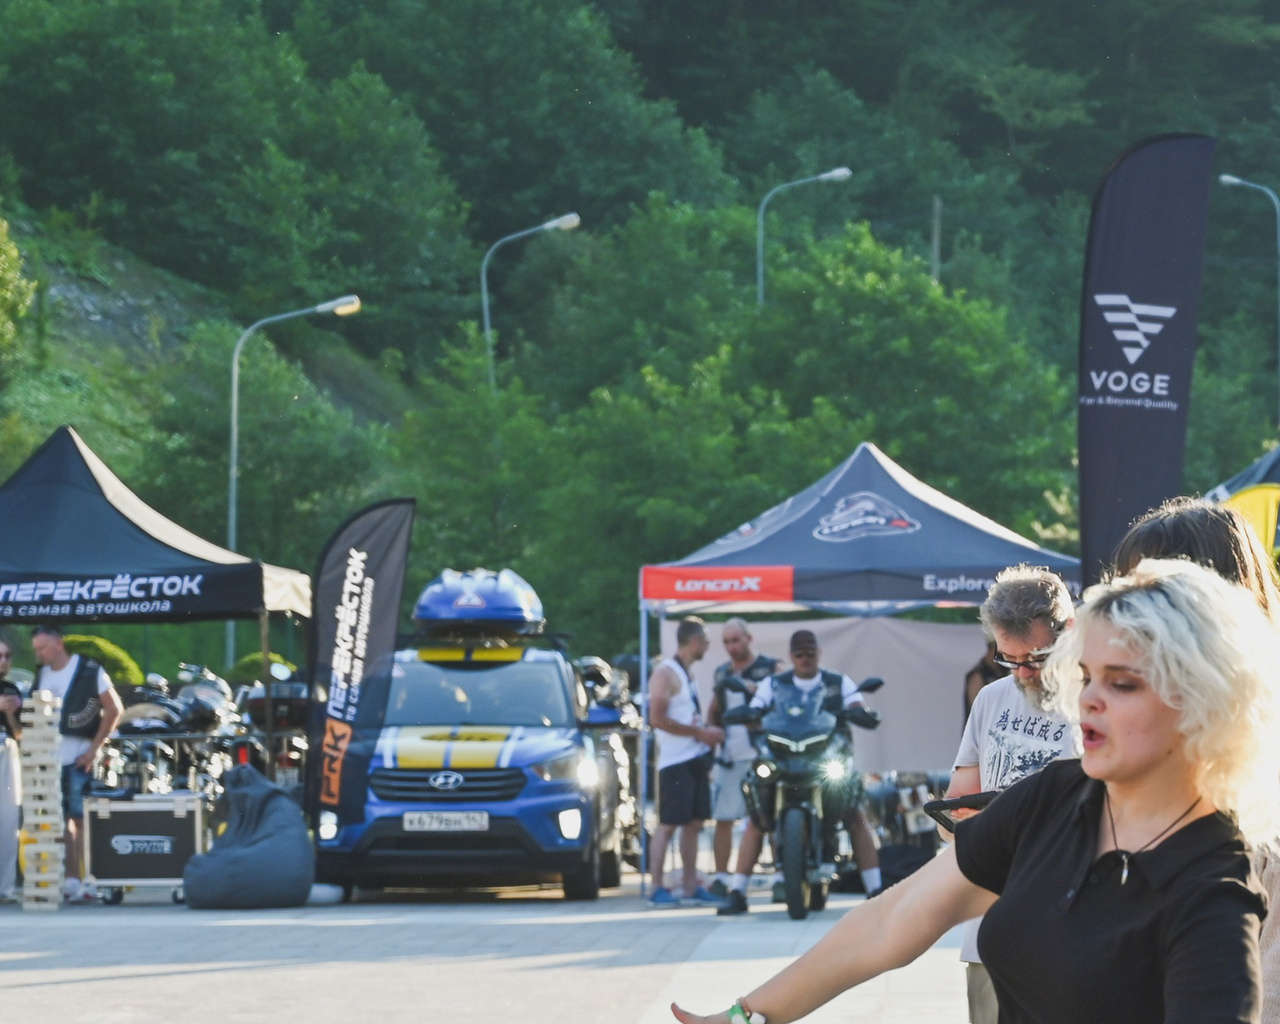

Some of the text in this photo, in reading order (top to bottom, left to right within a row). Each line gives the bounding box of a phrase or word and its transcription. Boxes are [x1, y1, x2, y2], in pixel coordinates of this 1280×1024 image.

[1089, 371, 1170, 395] VOGE
[0, 573, 204, 602] ПЕРЕКРЁСТОК
[17, 603, 71, 617] самая
[75, 599, 172, 616] автошкола
